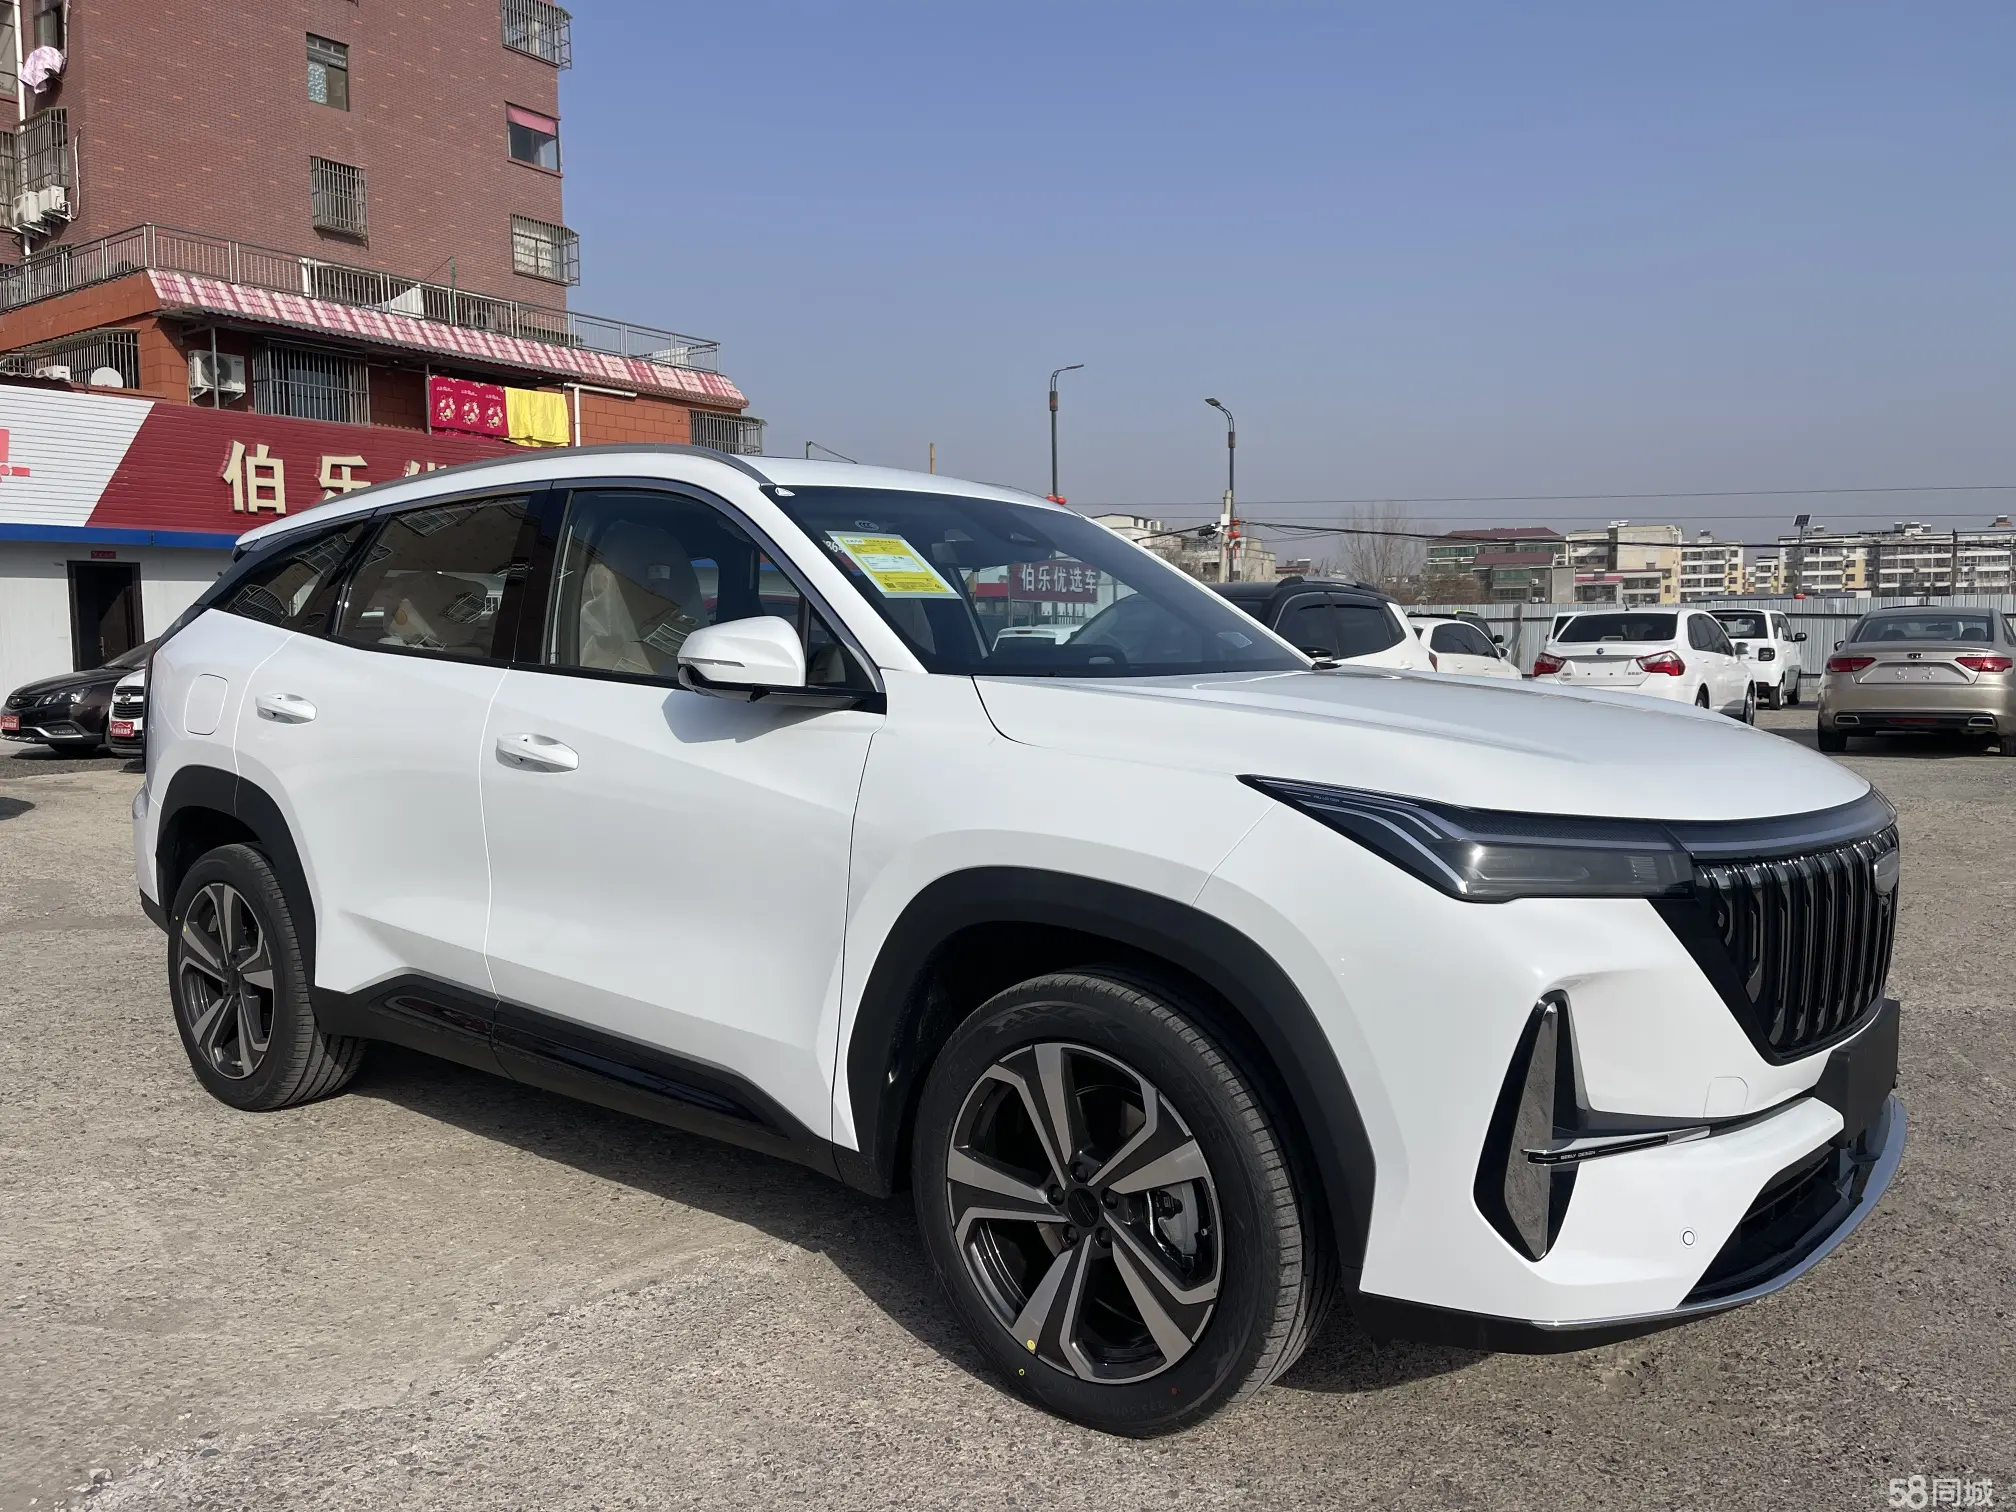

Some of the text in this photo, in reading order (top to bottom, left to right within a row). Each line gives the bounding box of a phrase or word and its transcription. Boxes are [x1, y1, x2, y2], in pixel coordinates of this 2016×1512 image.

[222, 440, 448, 515] 伯乐
[1021, 563, 1096, 594] 伯乐优选车
